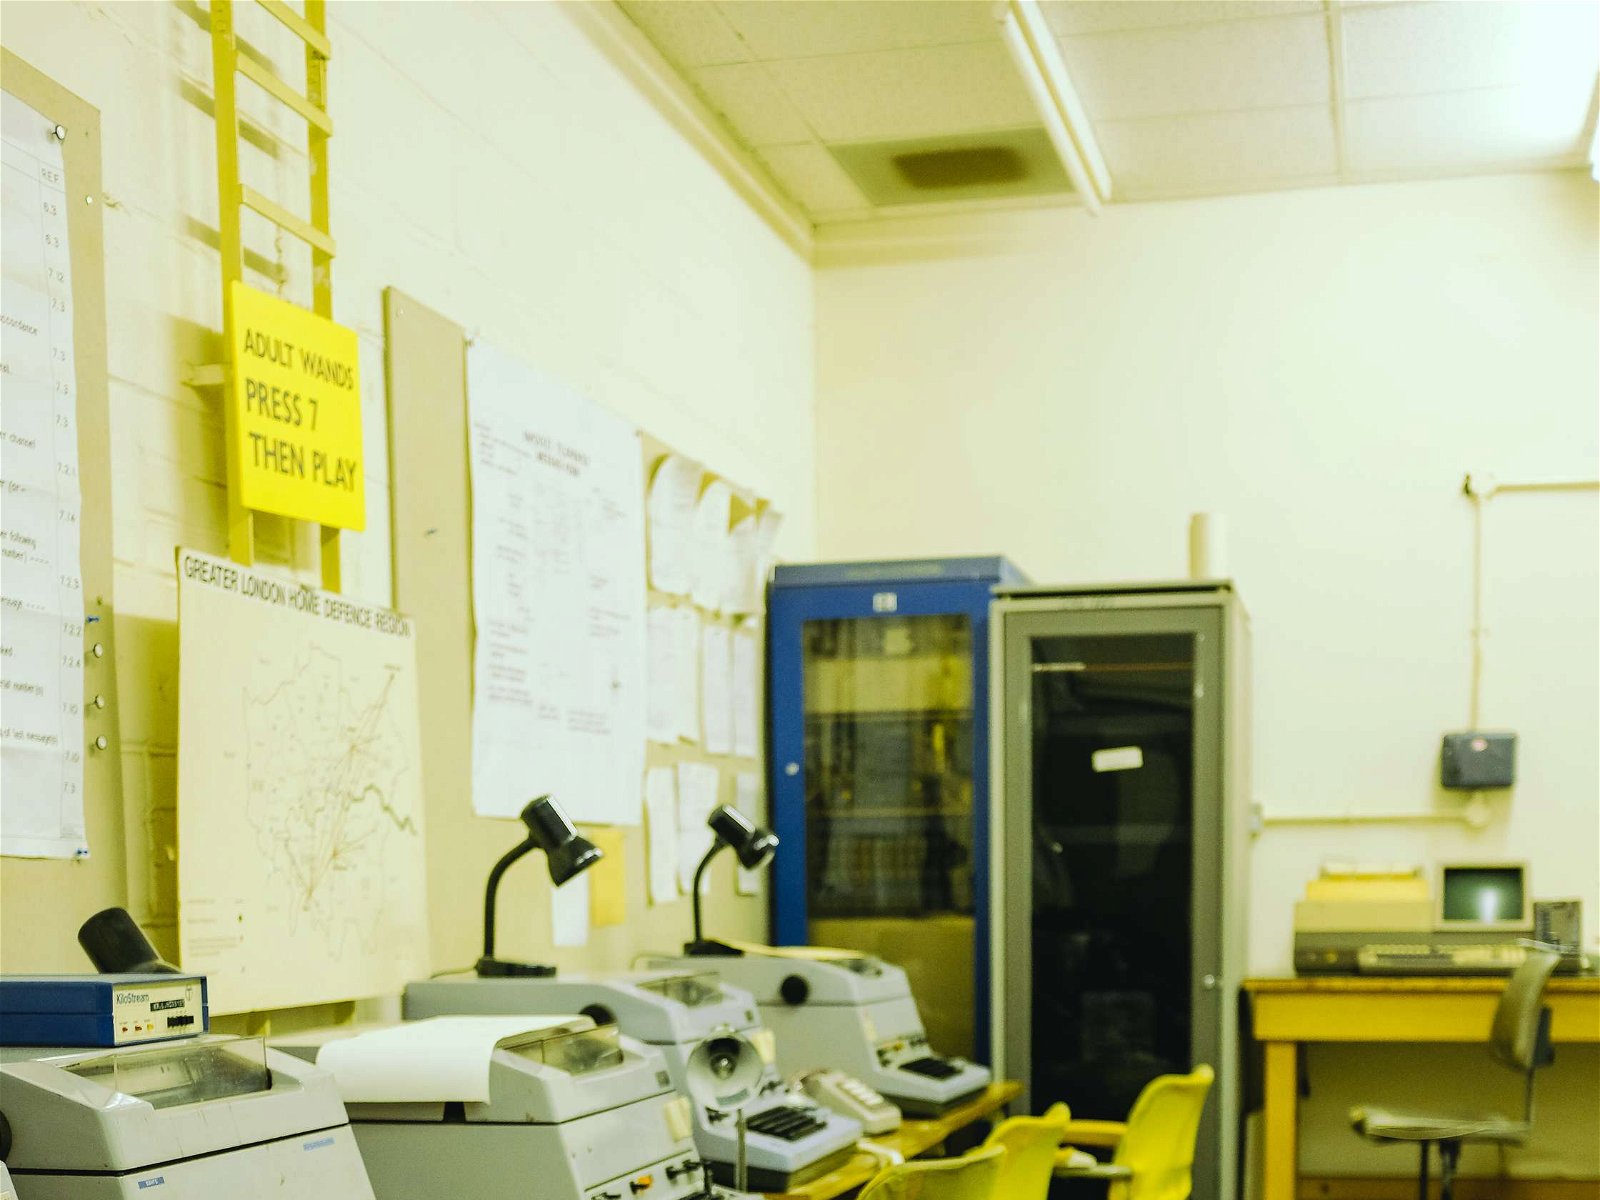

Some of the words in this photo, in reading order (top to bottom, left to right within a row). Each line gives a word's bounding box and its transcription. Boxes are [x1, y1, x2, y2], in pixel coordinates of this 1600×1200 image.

[244, 329, 295, 368] ADULT
[301, 347, 354, 390] WANDS
[245, 378, 302, 427] PRESS
[309, 399, 318, 431] 7
[249, 432, 305, 479] THEN
[312, 450, 356, 492] PLAY
[184, 555, 238, 592] GREATER
[241, 575, 286, 604] LONDON
[288, 586, 321, 616] HOME
[323, 598, 372, 629] DEFENCE
[375, 610, 412, 637] REGION
[116, 992, 150, 1005] KiloStream
